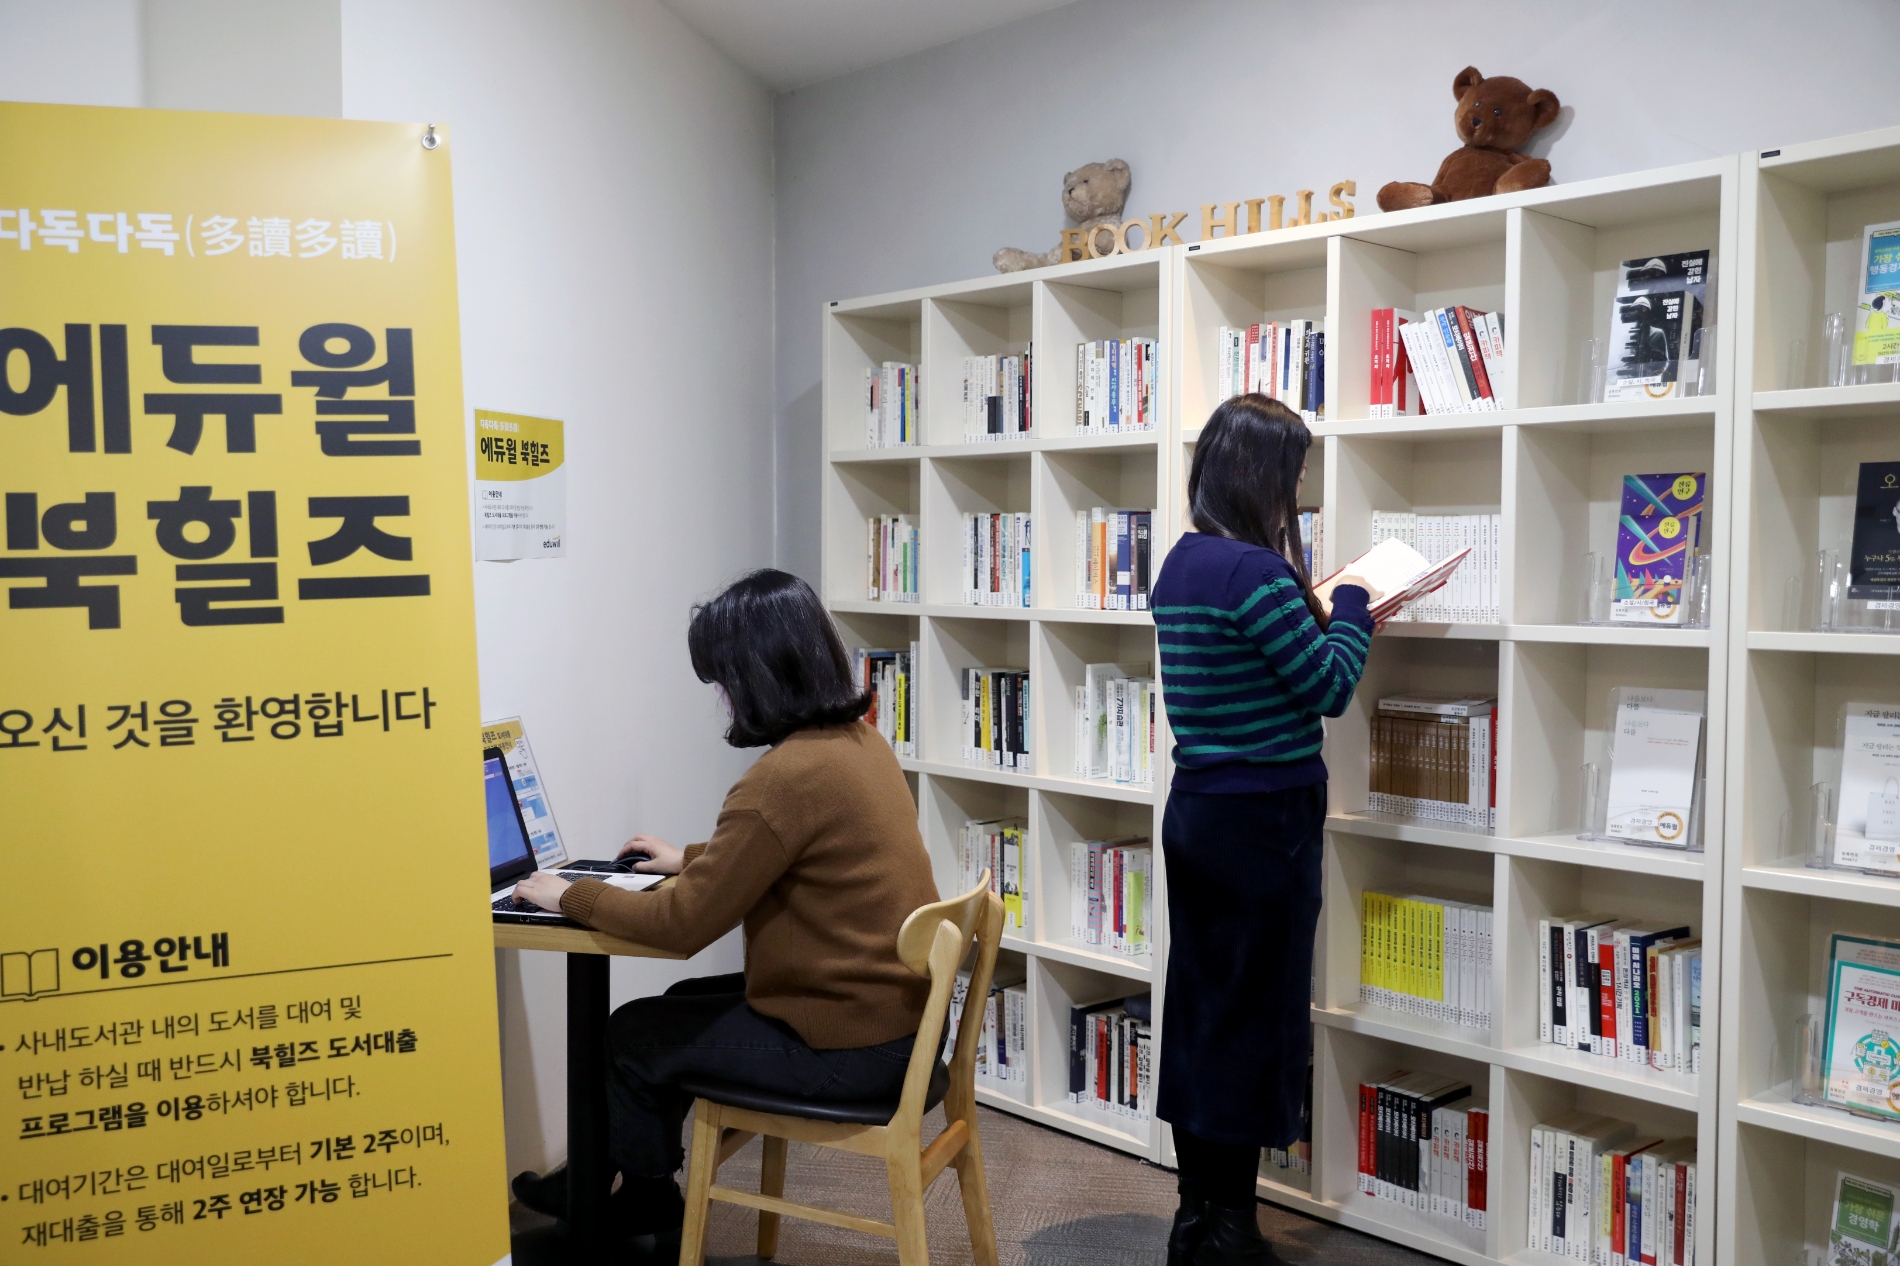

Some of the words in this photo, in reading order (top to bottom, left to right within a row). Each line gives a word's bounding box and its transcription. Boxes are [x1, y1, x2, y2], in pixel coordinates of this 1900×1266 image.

[0, 208, 397, 262] 다독다독(多讀多讀)
[1060, 211, 1188, 265] BOOK
[1199, 179, 1356, 241] HILLS
[0, 323, 422, 457] 에듀윌
[480, 437, 517, 465] 에듀윌
[520, 440, 550, 467] 북힐즈
[0, 485, 431, 630] 북힐즈
[0, 704, 88, 752] 오신
[106, 699, 199, 750] 것을
[213, 687, 437, 742] 환영합니다
[1659, 822, 1678, 831] 에듀윌
[72, 932, 230, 979] 이용안내
[15, 1021, 144, 1055] 사내도서관
[152, 1013, 199, 1040] 내의
[208, 1003, 279, 1034] 도서를
[287, 998, 331, 1024] 대여
[340, 995, 363, 1019] 및
[1634, 989, 1642, 1014] 2021
[1844, 990, 1889, 1010] 구독경제
[18, 1070, 71, 1100] 반납
[79, 1062, 129, 1091] 하실
[137, 1058, 162, 1083] 때
[169, 1048, 242, 1082] 반드시
[249, 1040, 321, 1071] 북힐즈
[327, 1028, 418, 1059] 도서대출
[18, 1101, 149, 1140] 프로그램을
[157, 1085, 279, 1121] 이용하셔야
[285, 1075, 361, 1108] 합니다.
[18, 1164, 149, 1205] 대여기간은
[157, 1142, 301, 1185] 대여일로부터
[310, 1134, 357, 1161] 기본
[363, 1122, 451, 1155] 2주이며,
[21, 1208, 127, 1248] 재대출을
[134, 1200, 185, 1235] 통해
[192, 1194, 232, 1221] 2주
[239, 1184, 288, 1216] 연장
[294, 1177, 341, 1205] 가능
[348, 1166, 423, 1199] 합니다.
[1848, 1212, 1880, 1233] 경영학
